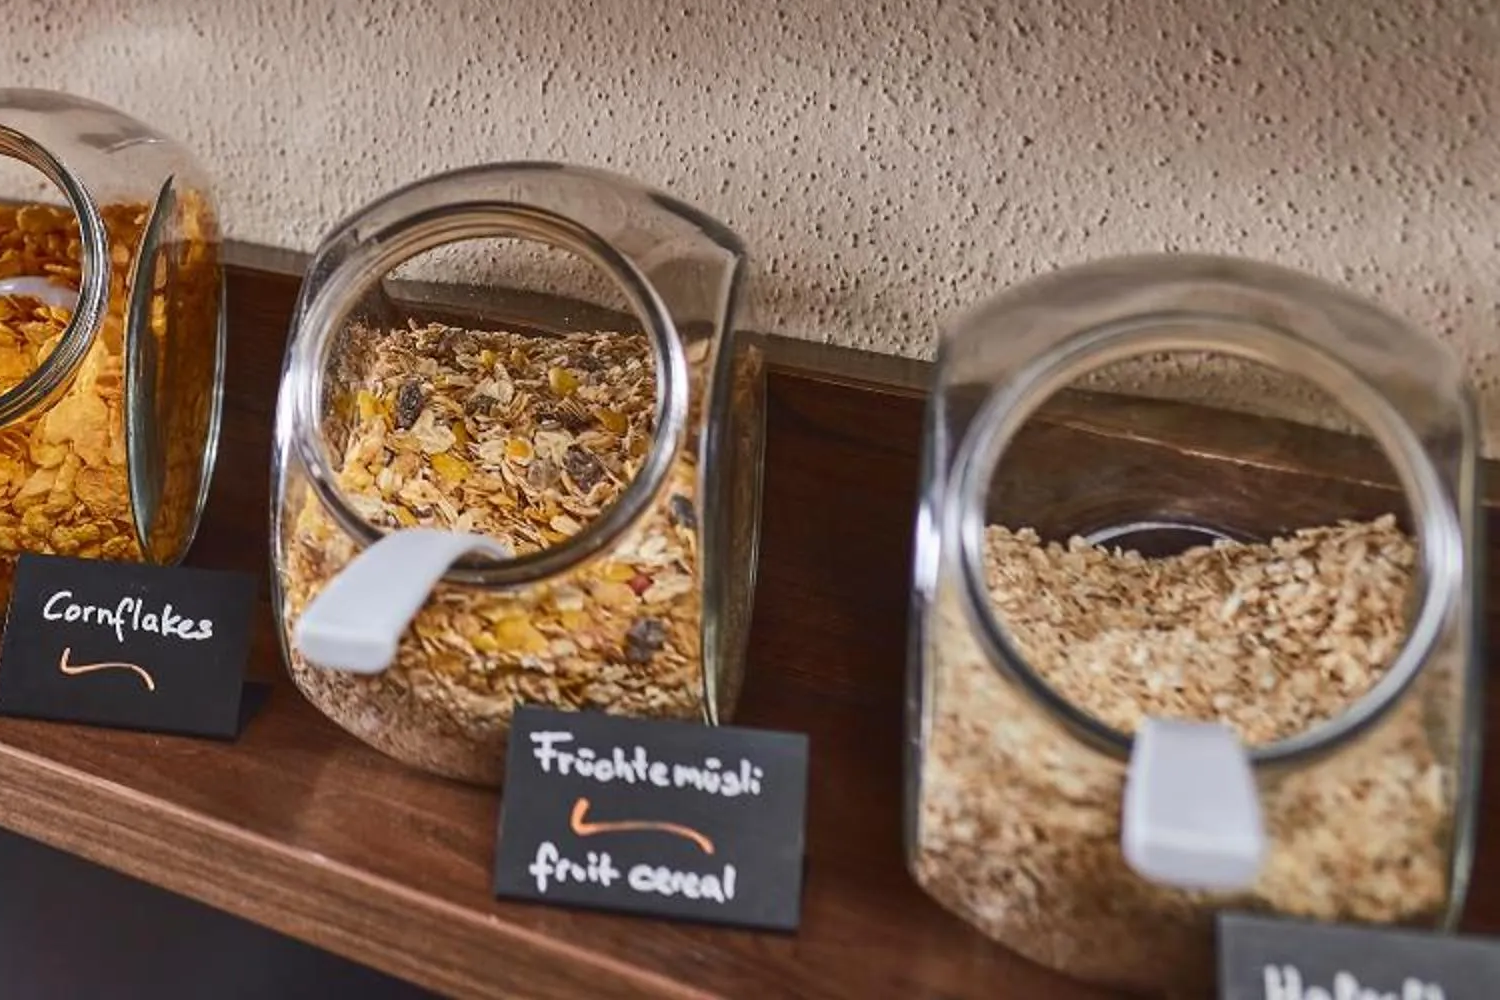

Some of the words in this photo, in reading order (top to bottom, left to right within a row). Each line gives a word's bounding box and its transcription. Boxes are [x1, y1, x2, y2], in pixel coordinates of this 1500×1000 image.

[42, 591, 213, 643] Cornflakes
[528, 841, 621, 894] fruit
[627, 864, 737, 904] cereal
